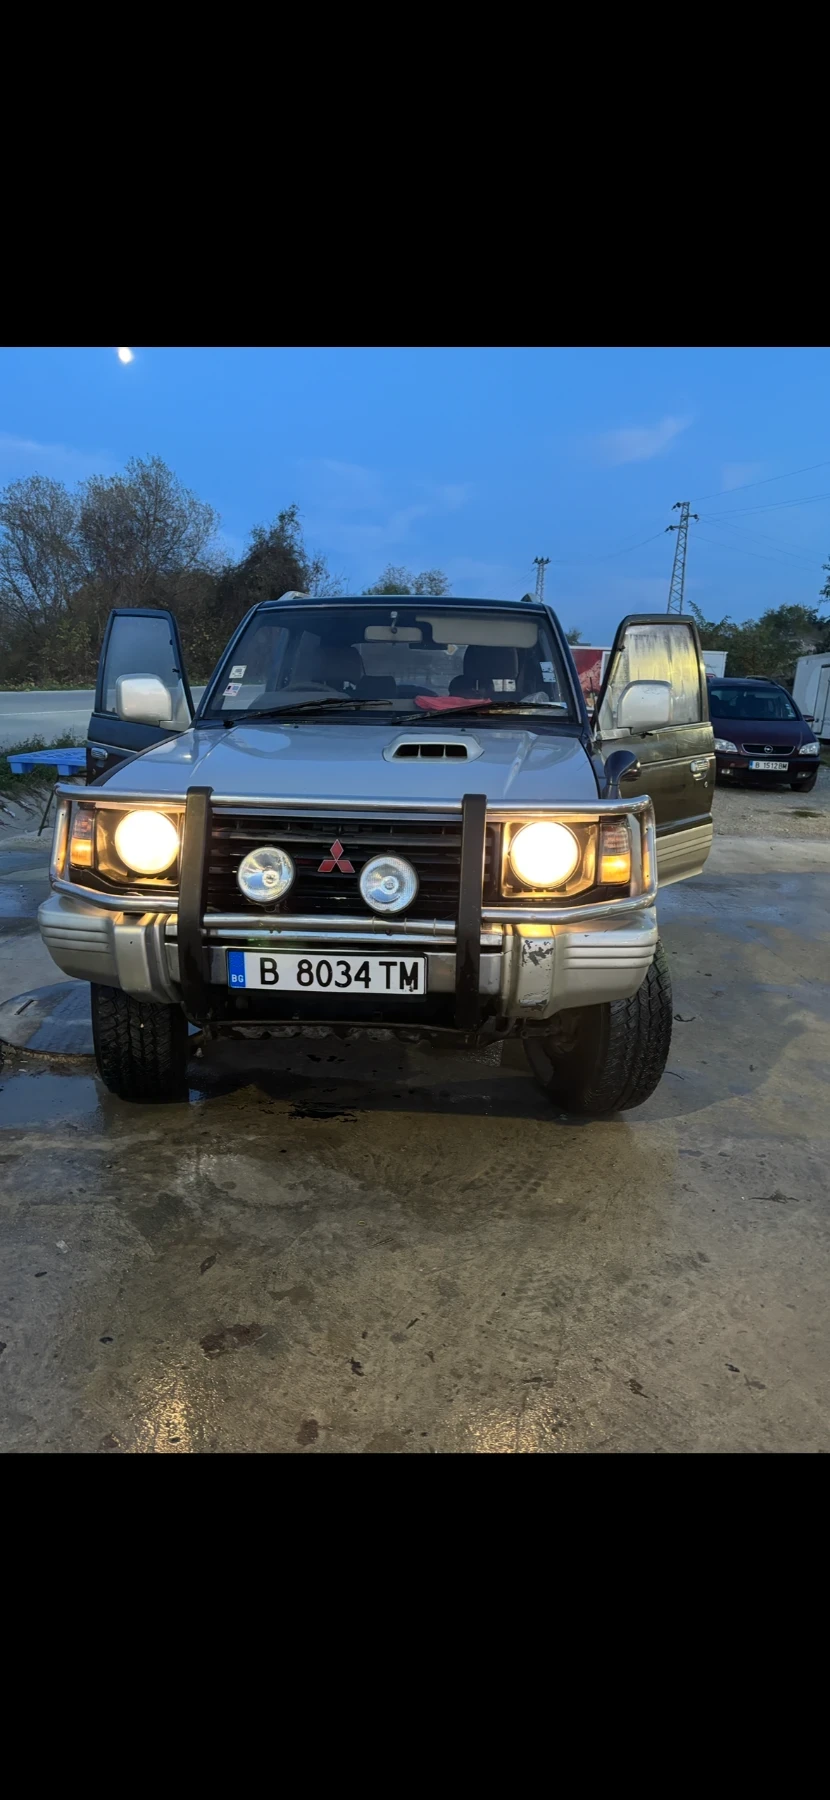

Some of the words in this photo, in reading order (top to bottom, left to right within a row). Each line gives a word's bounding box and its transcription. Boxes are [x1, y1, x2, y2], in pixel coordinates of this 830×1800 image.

[231, 974, 244, 983] BG
[260, 957, 279, 985] B
[296, 959, 371, 989] 8034
[379, 961, 419, 991] TM
